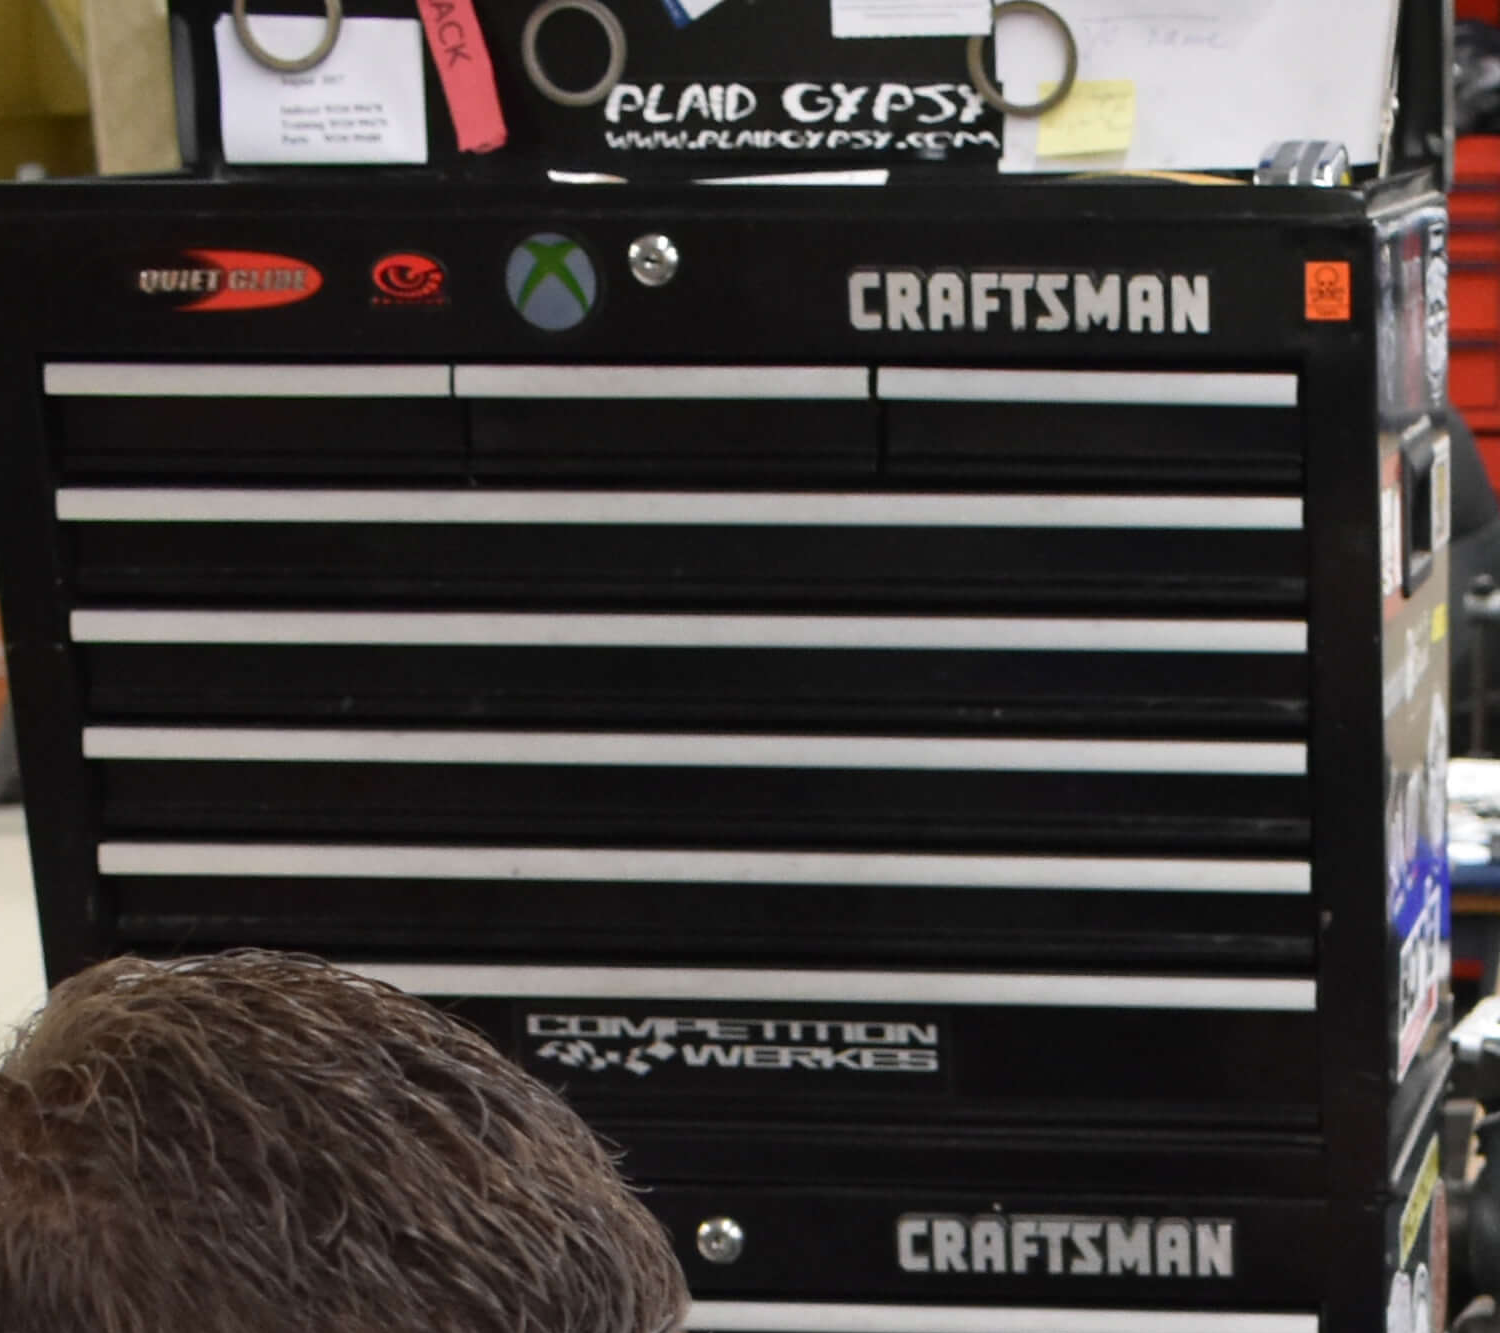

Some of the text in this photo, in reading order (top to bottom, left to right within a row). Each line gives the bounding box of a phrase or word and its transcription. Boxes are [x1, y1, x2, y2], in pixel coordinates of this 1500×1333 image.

[604, 82, 984, 123] PLAID GYPSY
[139, 267, 308, 294] QUIET GLIDE
[848, 270, 1210, 334] CRAFTSMAN
[526, 1012, 938, 1044] COMPETITION
[681, 1043, 939, 1071] WERKES
[897, 1216, 1234, 1277] CRAFTSMAN
